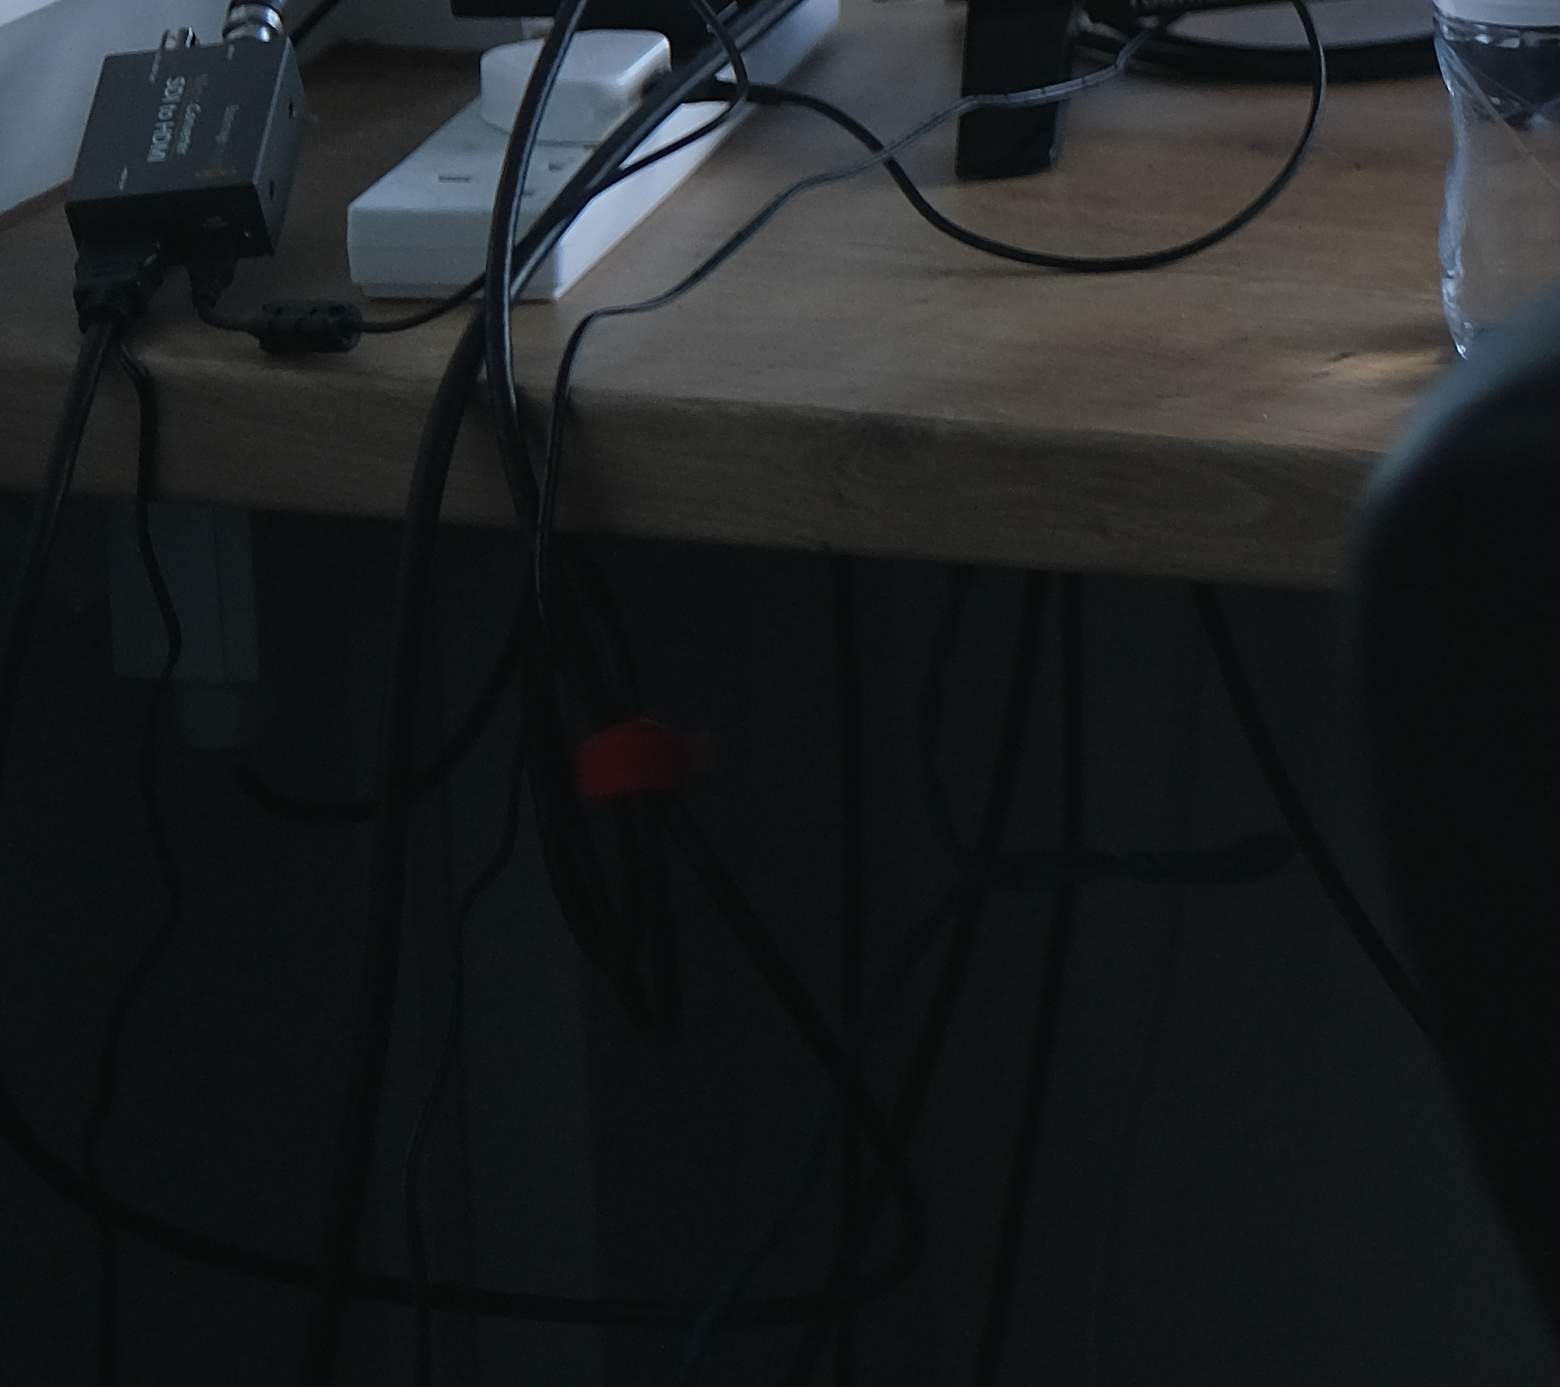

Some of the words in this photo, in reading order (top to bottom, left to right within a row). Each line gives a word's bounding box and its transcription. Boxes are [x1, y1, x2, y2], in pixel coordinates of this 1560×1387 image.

[161, 75, 186, 104] SDI
[157, 103, 178, 121] to
[146, 120, 176, 164] HDMI
